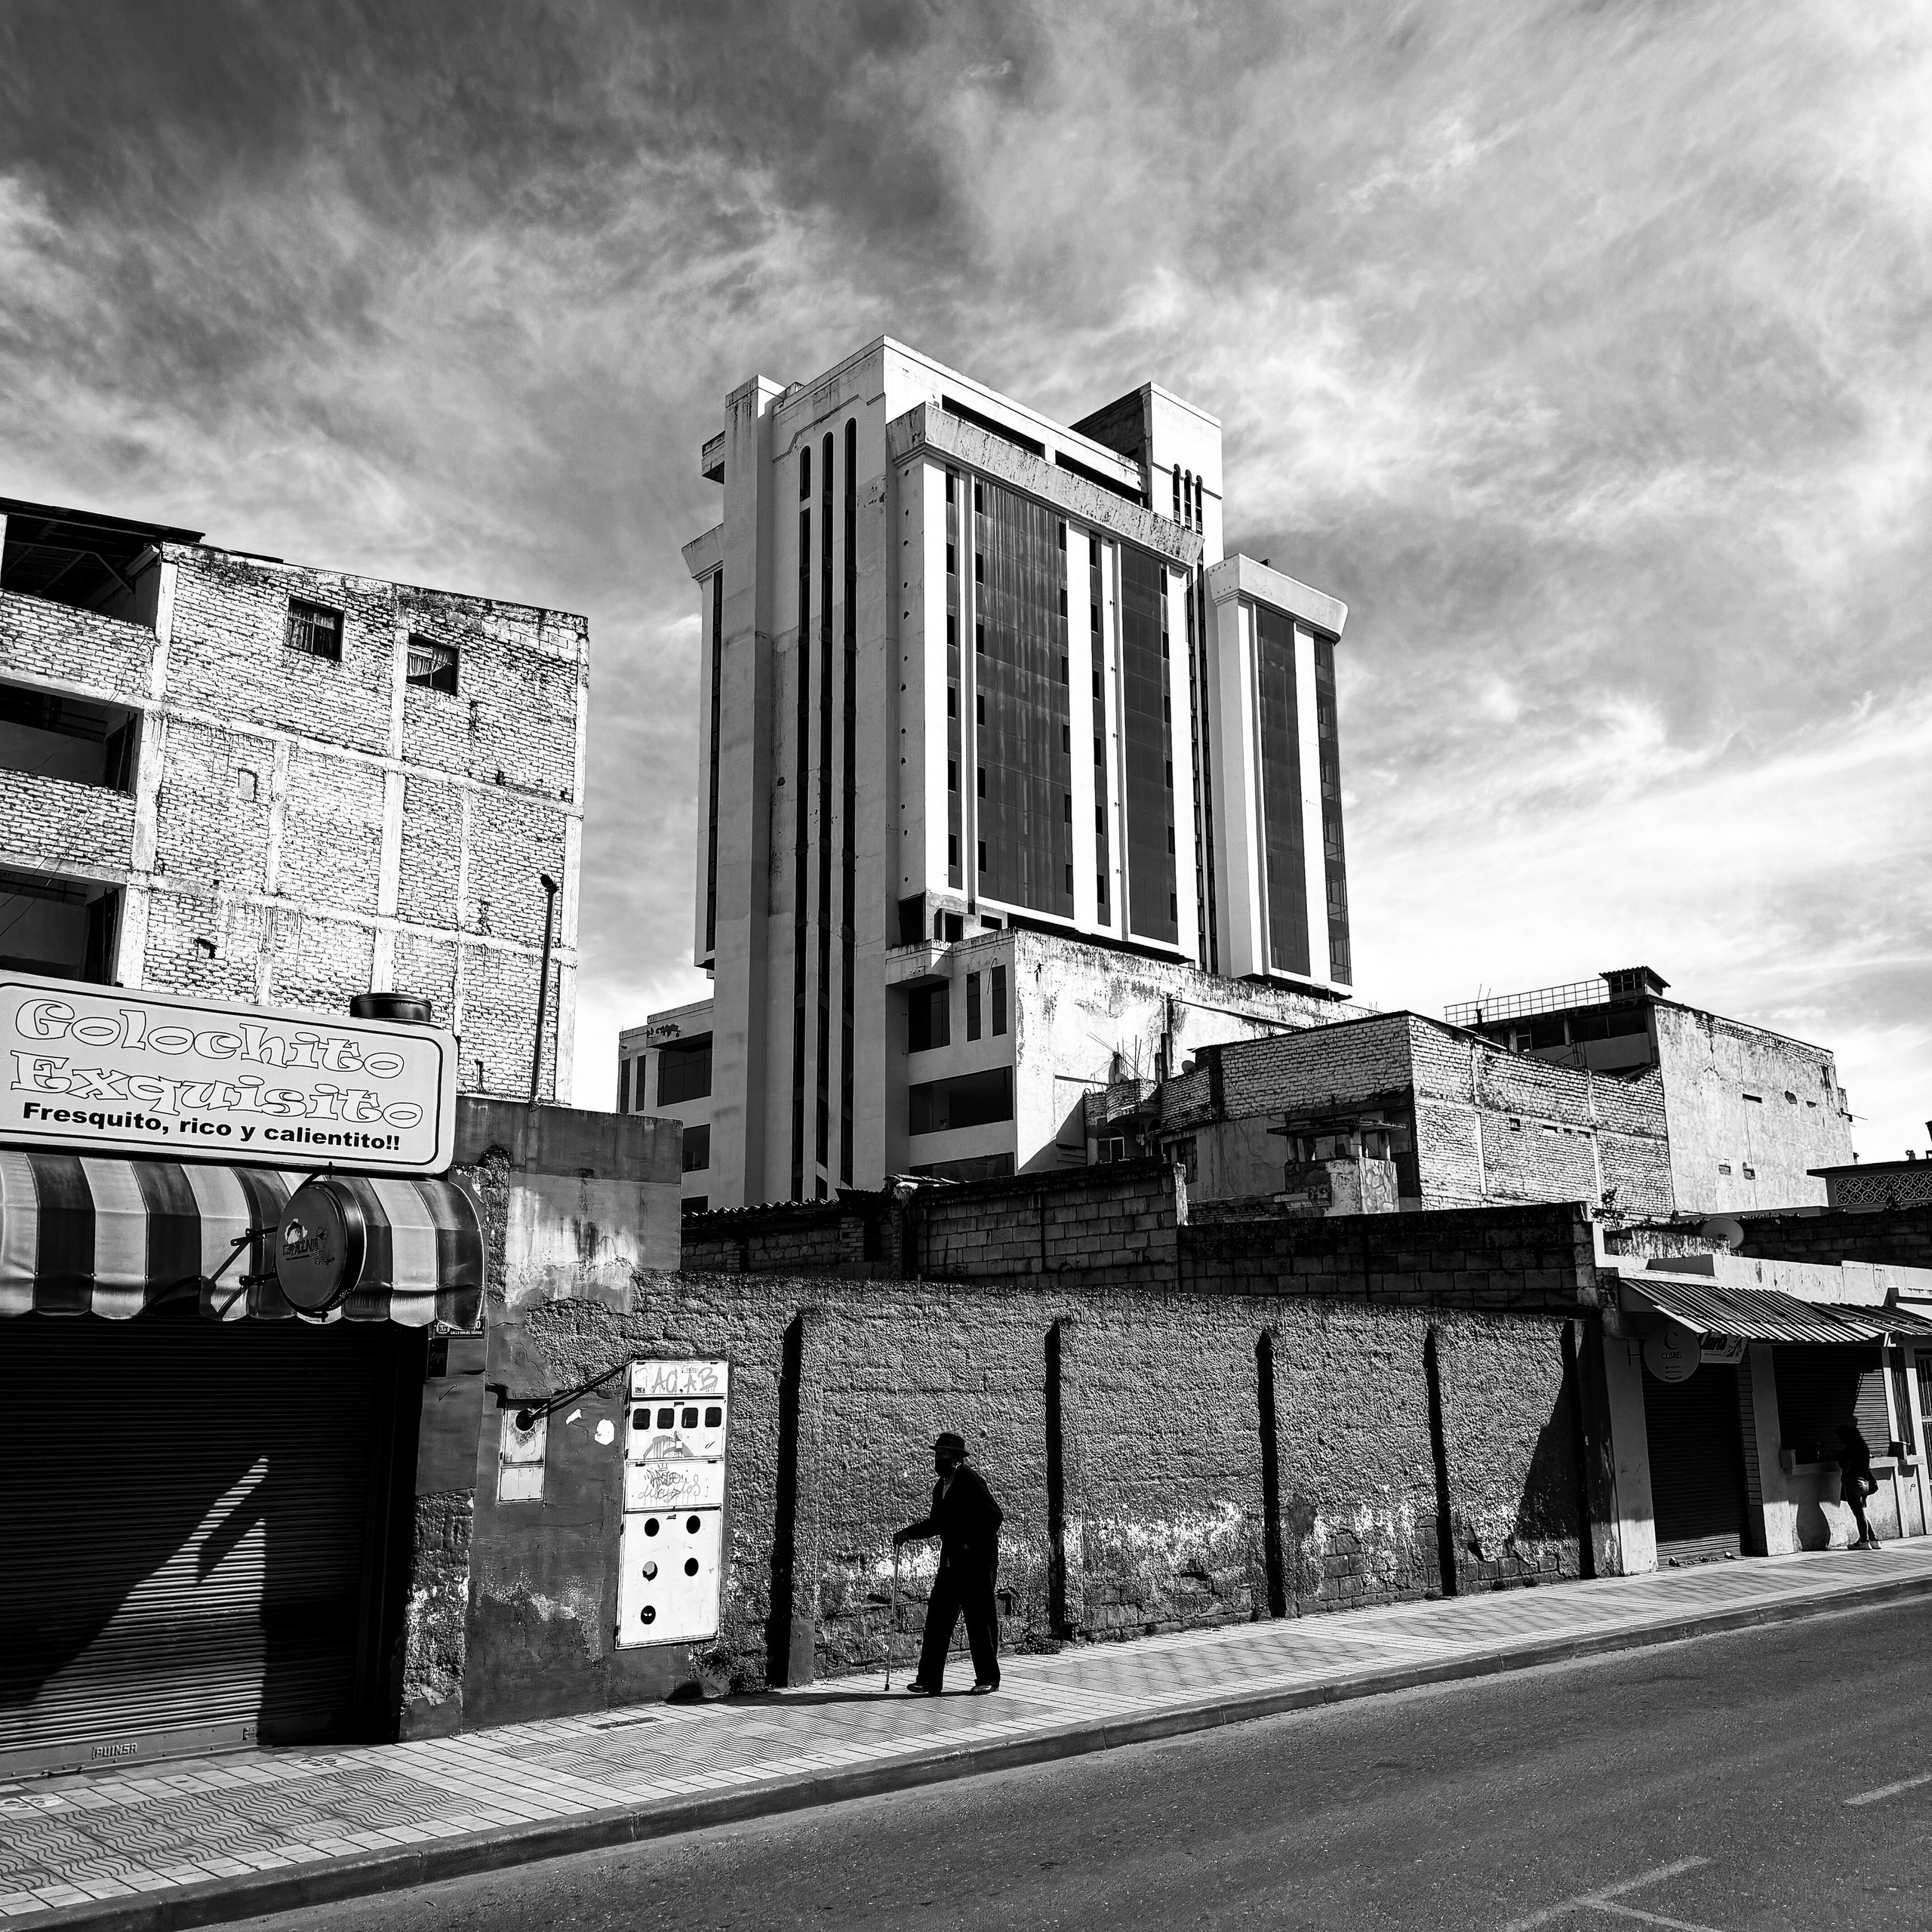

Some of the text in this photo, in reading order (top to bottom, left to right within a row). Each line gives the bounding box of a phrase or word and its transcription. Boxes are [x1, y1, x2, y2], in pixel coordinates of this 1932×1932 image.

[15, 998, 405, 1078] Golochito
[11, 1050, 423, 1128] Exquisito
[23, 1102, 400, 1150] Fresquito, rico y calientito!!
